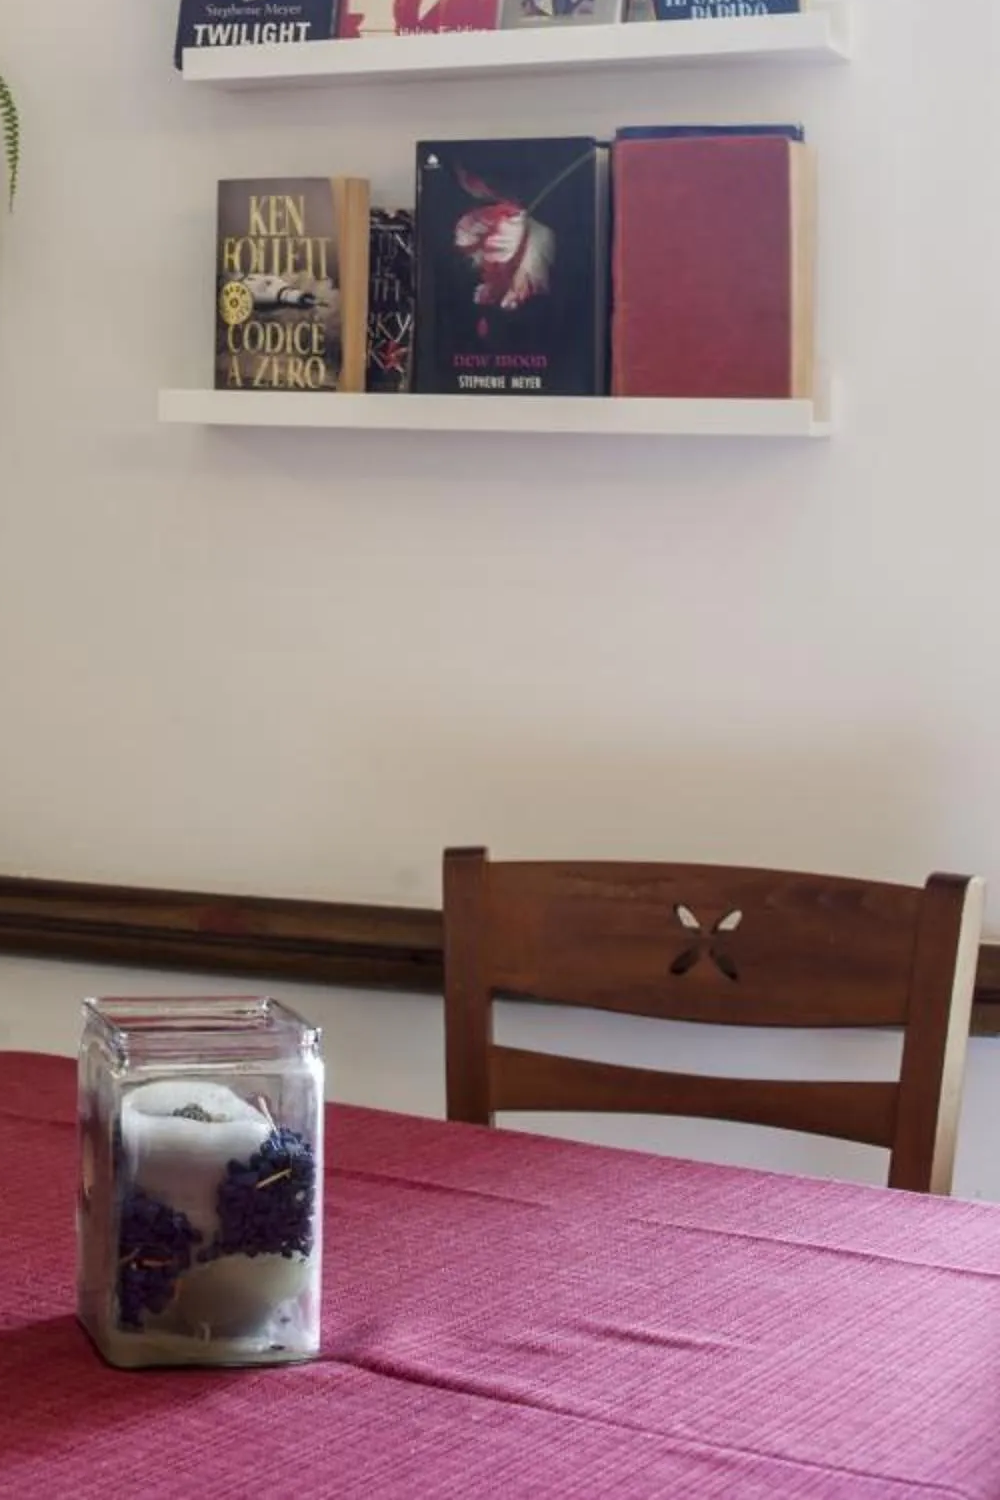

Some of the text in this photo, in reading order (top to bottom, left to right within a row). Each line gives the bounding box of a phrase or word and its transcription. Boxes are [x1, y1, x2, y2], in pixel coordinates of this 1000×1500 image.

[193, 21, 311, 46] TWILIGHT
[249, 195, 305, 236] KEN
[227, 320, 326, 355] CODICE
[252, 354, 326, 388] ZERO
